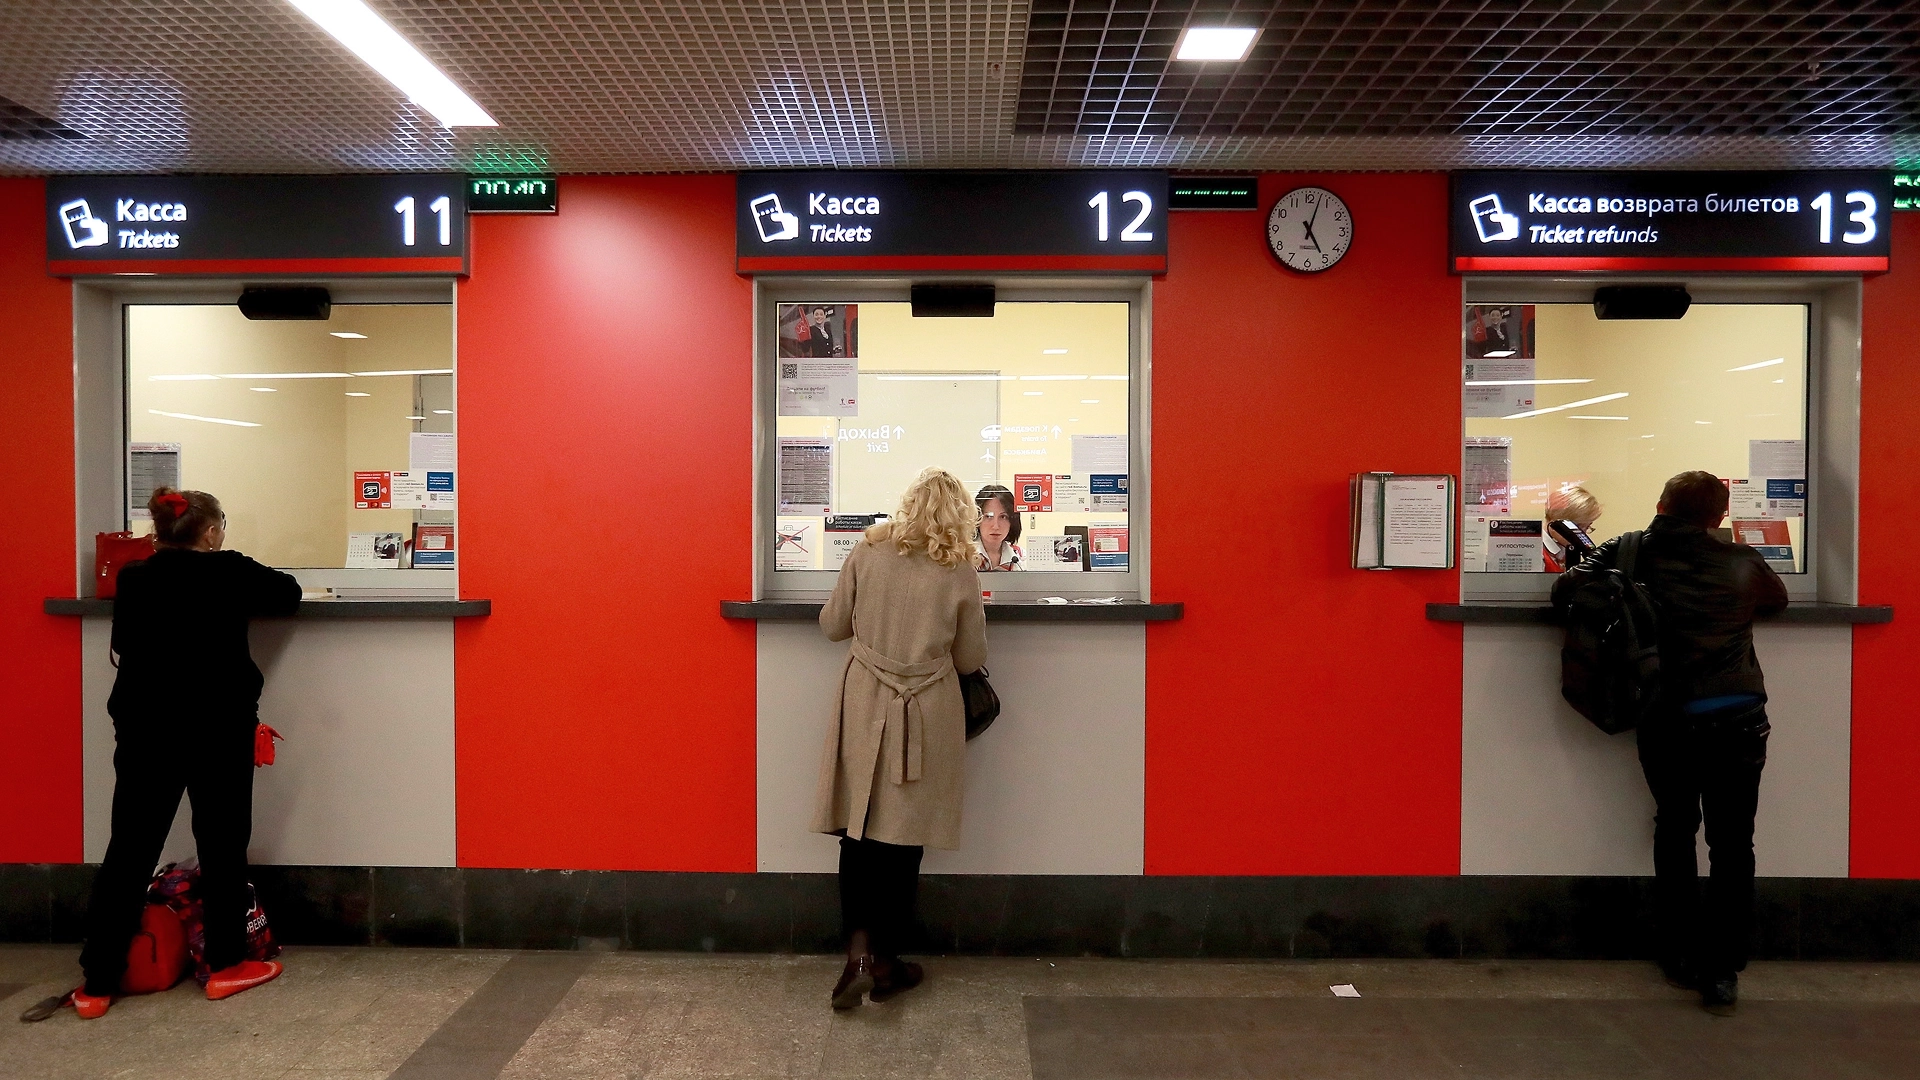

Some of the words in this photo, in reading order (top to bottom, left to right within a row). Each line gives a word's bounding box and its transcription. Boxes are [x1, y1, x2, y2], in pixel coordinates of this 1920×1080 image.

[809, 192, 880, 216] Касса
[1290, 198, 1299, 208] 11
[1305, 194, 1314, 204] 12
[1528, 193, 1591, 213] Касса
[1596, 196, 1698, 217] возврата
[1705, 193, 1799, 213] билетов
[116, 199, 187, 222] Касса
[1278, 209, 1287, 218] 10
[394, 196, 451, 246] 11
[1088, 190, 1154, 242] 12
[1334, 211, 1342, 221] 2
[1809, 191, 1877, 245] 13
[809, 223, 873, 243] Tickets
[1271, 225, 1280, 234] 9
[1338, 227, 1346, 237] 3
[1528, 226, 1584, 243] Ticket
[1587, 225, 1659, 243] refunds
[117, 229, 180, 249] Tickets
[1276, 241, 1284, 250] 8
[1332, 243, 1340, 252] 4
[1288, 253, 1296, 262] 7
[1321, 254, 1329, 264] 5
[1303, 258, 1312, 268] 6
